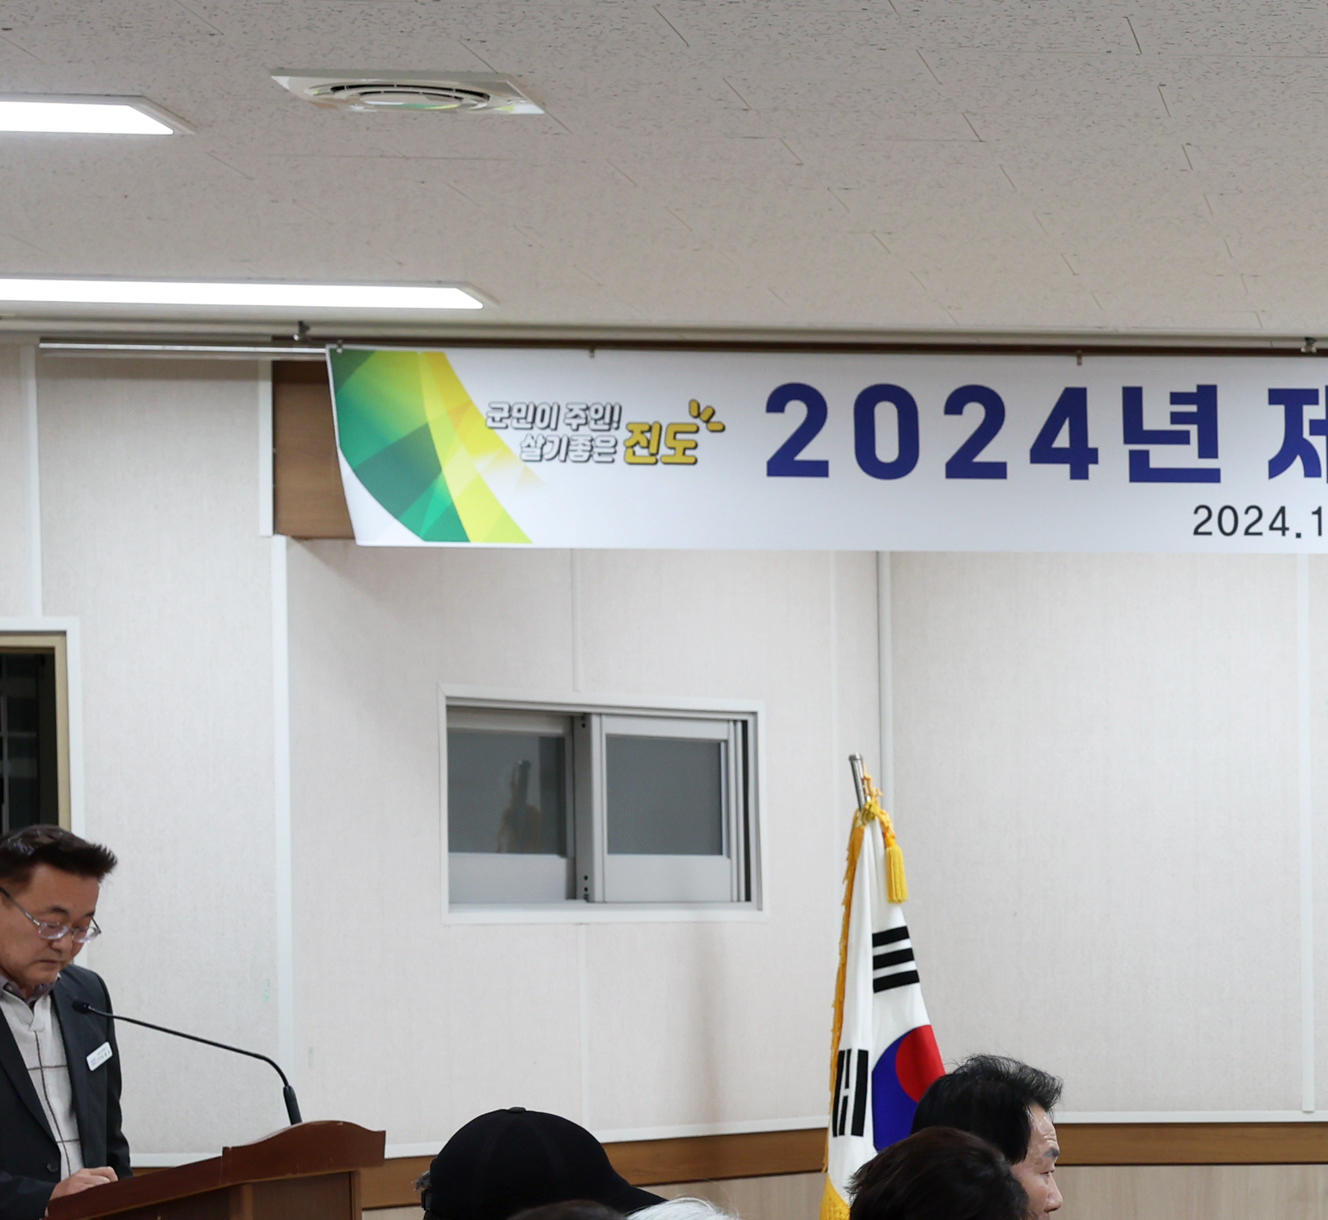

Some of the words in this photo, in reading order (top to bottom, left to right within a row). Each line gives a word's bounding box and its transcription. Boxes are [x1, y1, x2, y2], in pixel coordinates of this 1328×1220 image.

[486, 401, 560, 431] 군민이
[563, 402, 622, 431] 주인!
[766, 382, 1221, 484] 2024년
[520, 433, 617, 464] 살기좋은
[623, 421, 699, 465] 진도
